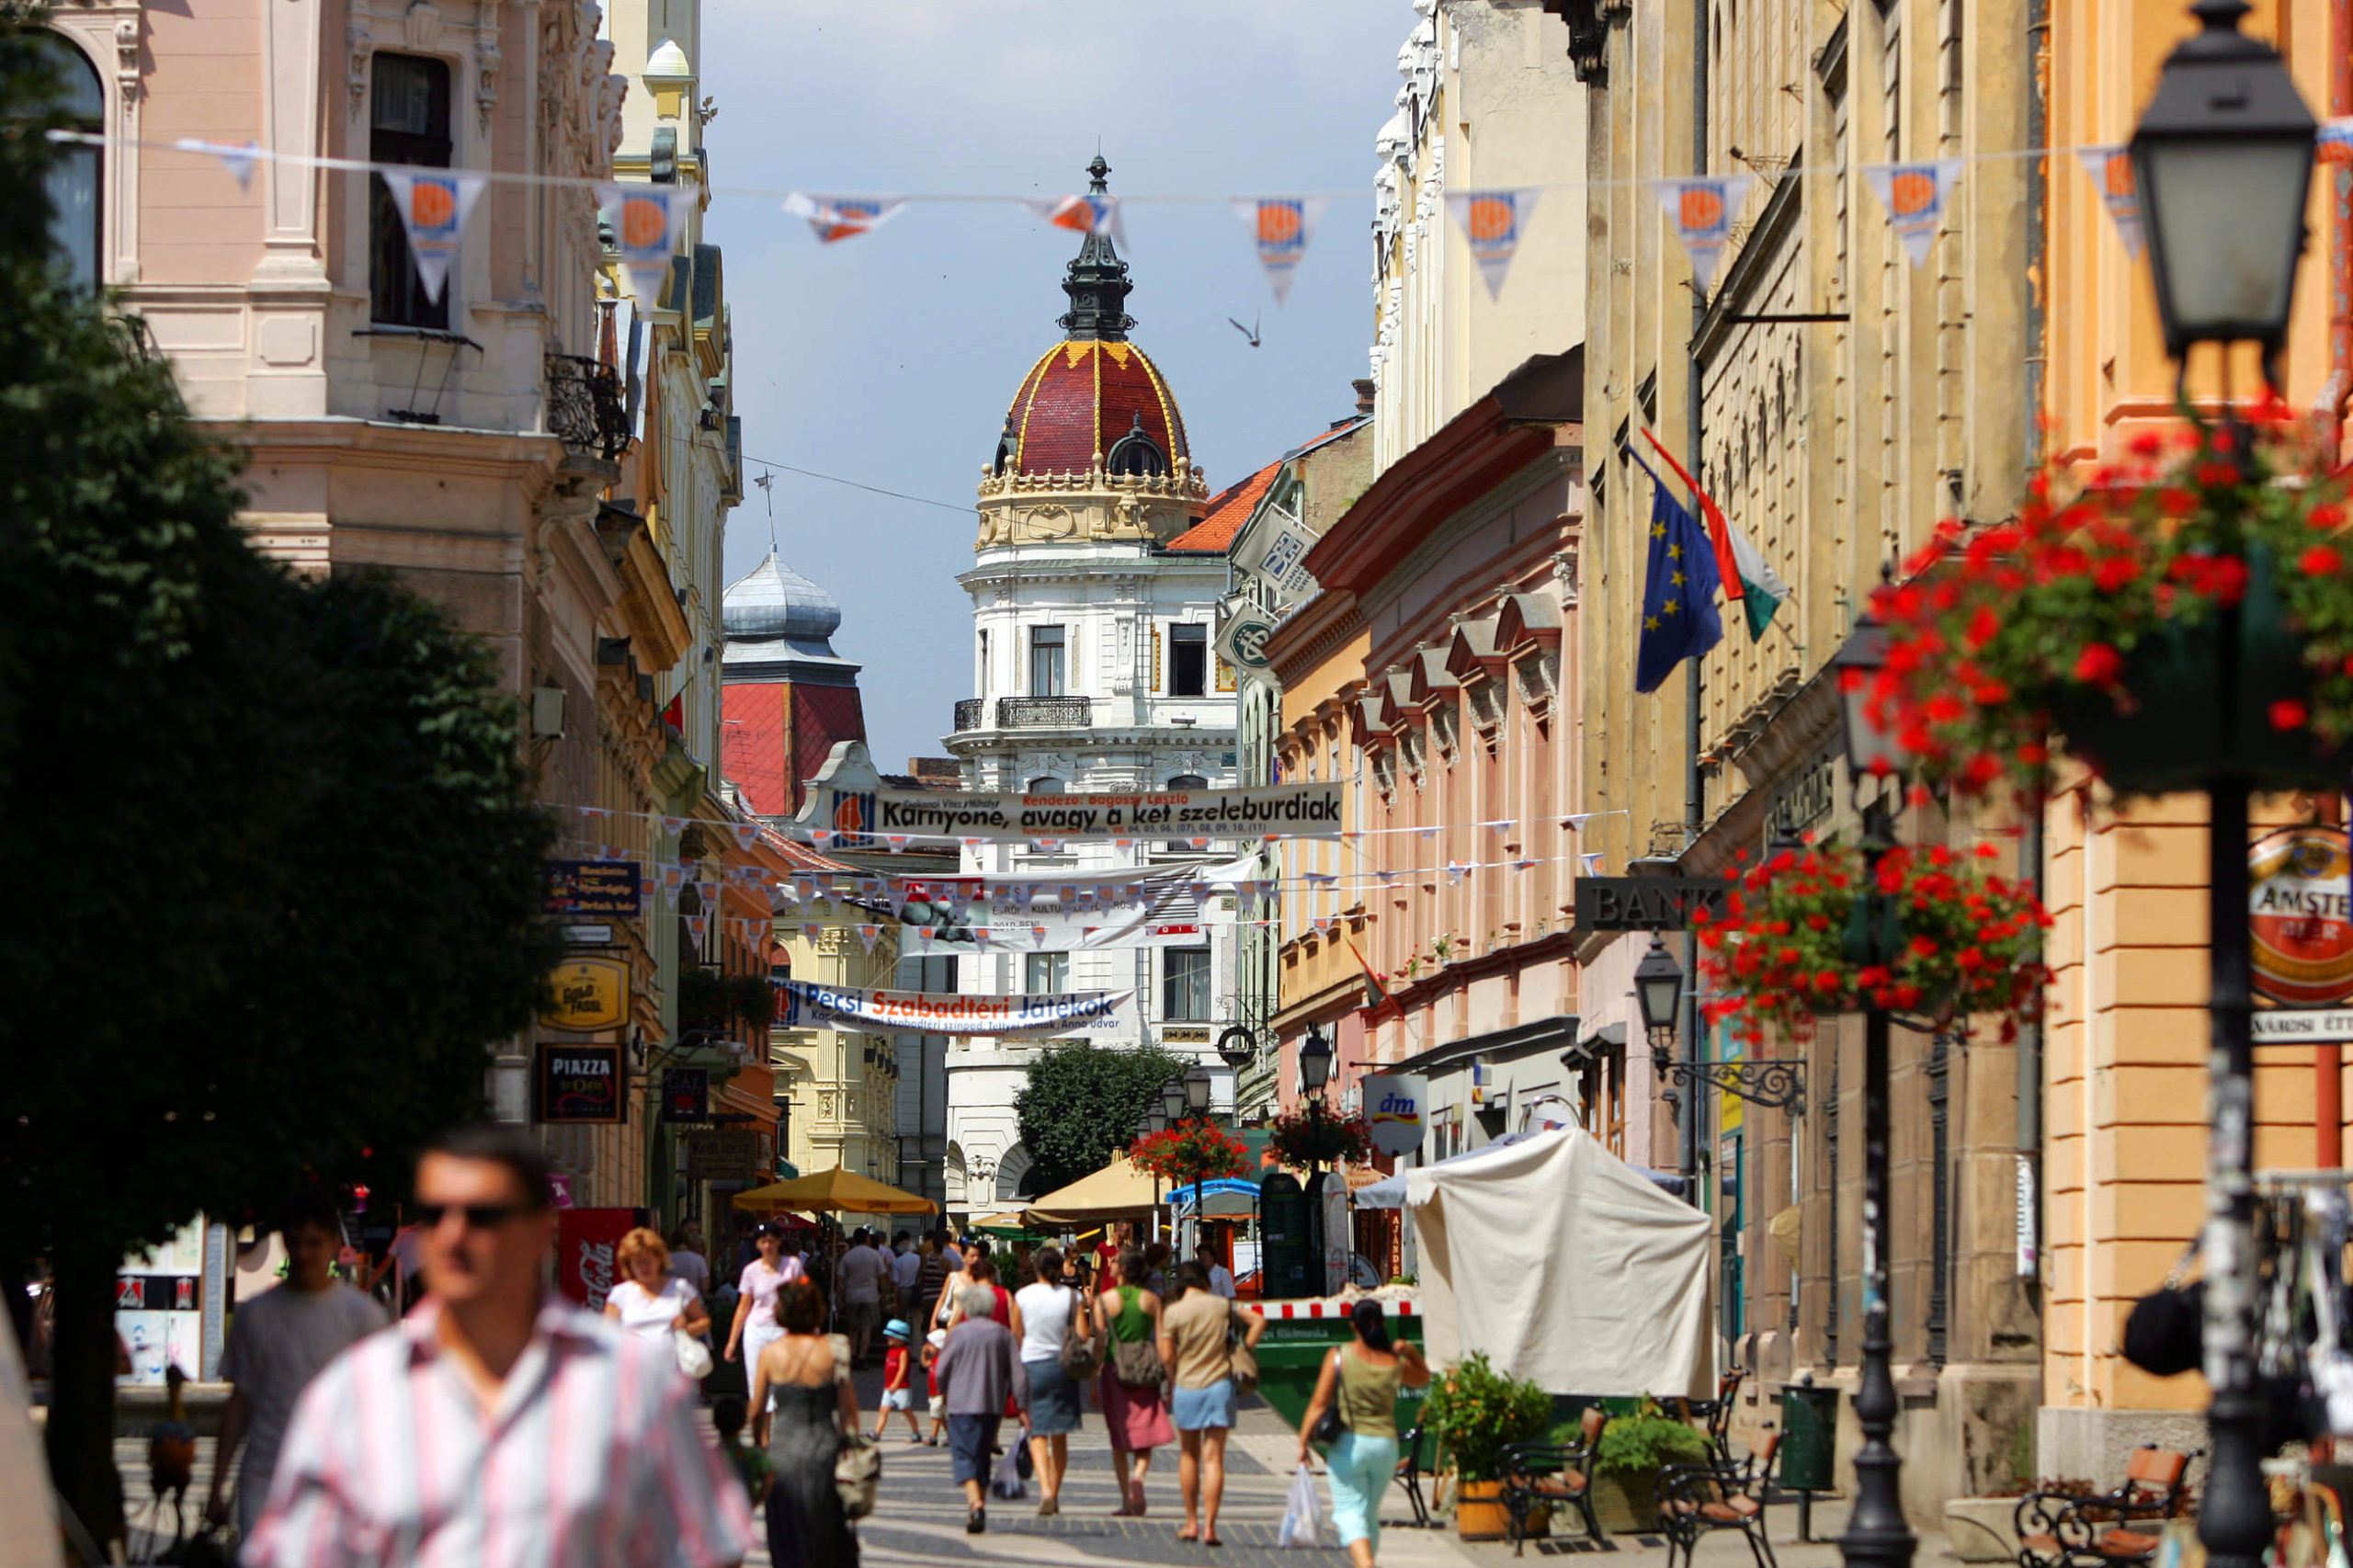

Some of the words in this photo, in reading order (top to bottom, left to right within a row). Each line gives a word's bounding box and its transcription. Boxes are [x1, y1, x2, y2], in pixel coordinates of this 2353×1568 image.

[1020, 807, 1097, 830] avagy
[1107, 807, 1121, 825] a
[1178, 791, 1341, 822] szeleburdiak
[1592, 885, 1723, 922] BANK
[805, 983, 863, 1013] Pécsi
[872, 992, 1009, 1020] Szabadtéri
[1017, 992, 1115, 1019] Játékok
[551, 1058, 611, 1076] PIAZZA
[1380, 1092, 1415, 1113] dm
